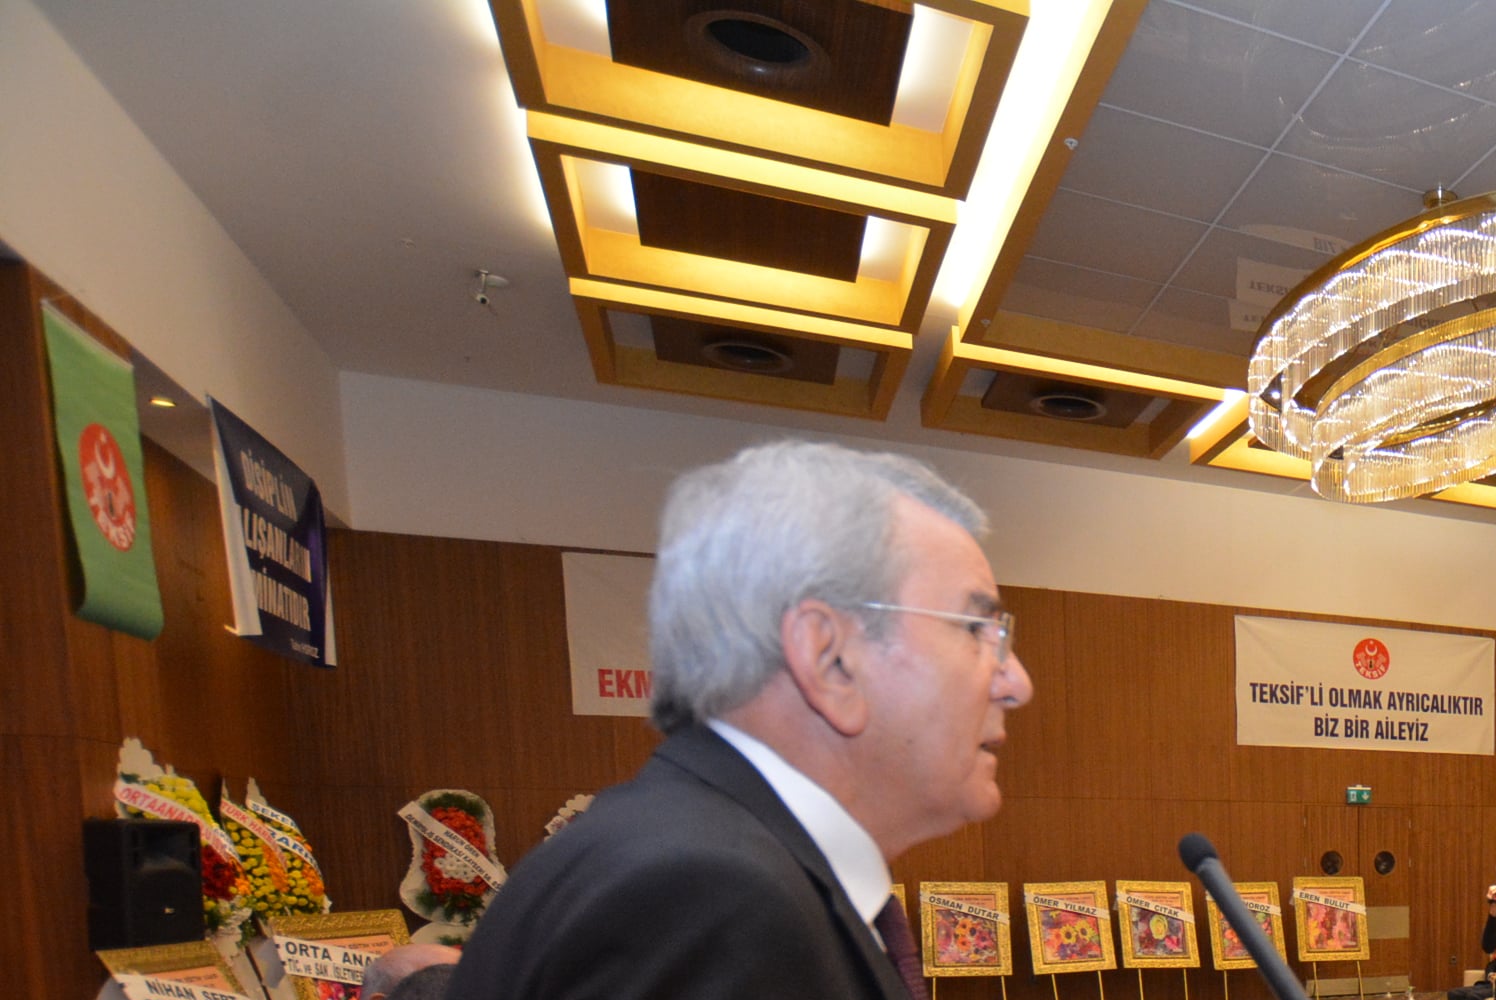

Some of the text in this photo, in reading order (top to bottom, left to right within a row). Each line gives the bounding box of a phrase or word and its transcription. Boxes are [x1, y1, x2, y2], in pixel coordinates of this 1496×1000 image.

[240, 447, 298, 522] DİSİPLİN
[243, 506, 312, 584] LIŞANLARIN
[250, 567, 312, 632] MİNATIDIR
[597, 668, 656, 699] EKM
[1355, 660, 1386, 679] TEKSİF
[1328, 686, 1384, 710] OLMAK
[1387, 690, 1484, 716] AYRICALIKTIR
[1313, 713, 1429, 742] BİZ BİR AİLEYİZ
[928, 895, 963, 911] OSMAN
[967, 905, 1000, 920] DUTAR
[1064, 902, 1097, 915] YILMAZ
[1299, 891, 1321, 902] EREN
[1323, 897, 1351, 909] BULUT
[285, 941, 333, 961] ORTA
[342, 951, 374, 968] ANA
[144, 978, 198, 1000] NİHAN
